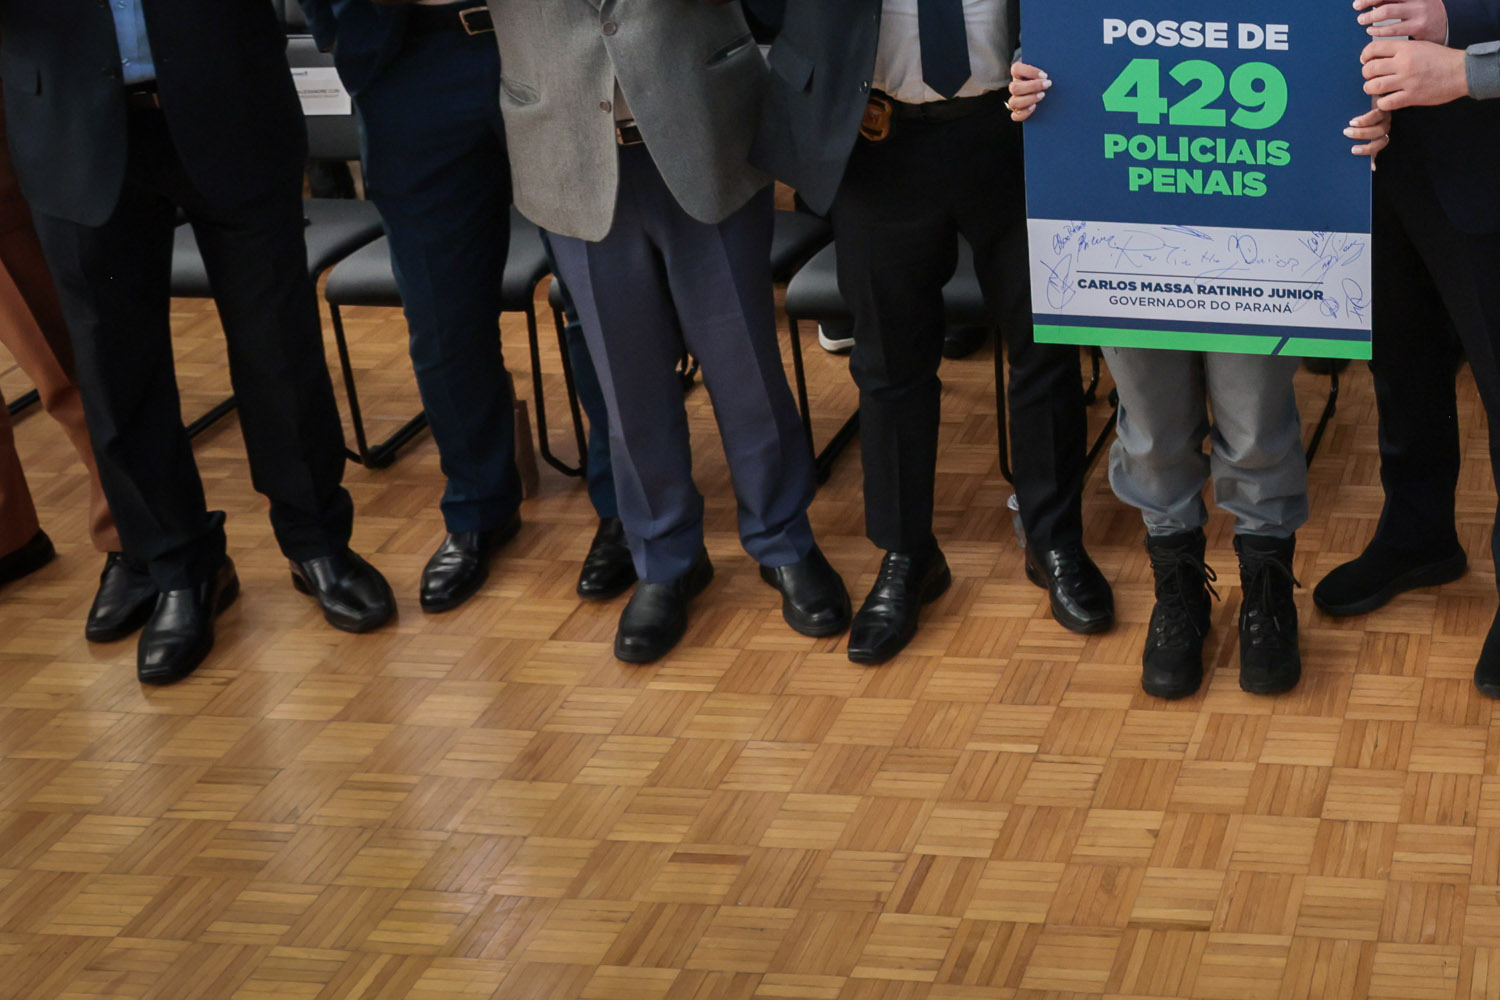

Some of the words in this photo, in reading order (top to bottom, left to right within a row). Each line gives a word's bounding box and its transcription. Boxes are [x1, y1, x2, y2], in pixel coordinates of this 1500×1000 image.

[1103, 18, 1229, 49] POSSE
[1238, 23, 1289, 51] DE
[1102, 58, 1288, 130] 429
[1104, 133, 1291, 167] POLICIAIS
[1128, 166, 1268, 197] PENAIS
[1077, 278, 1137, 291] CARLOS
[1141, 282, 1193, 294] MASSA
[1197, 285, 1264, 298] RATINHO
[1268, 288, 1324, 300] JUNIOR
[1109, 295, 1206, 309] GOVERNADOR
[1210, 300, 1231, 311] DO
[1235, 301, 1293, 314] PARANÁ
